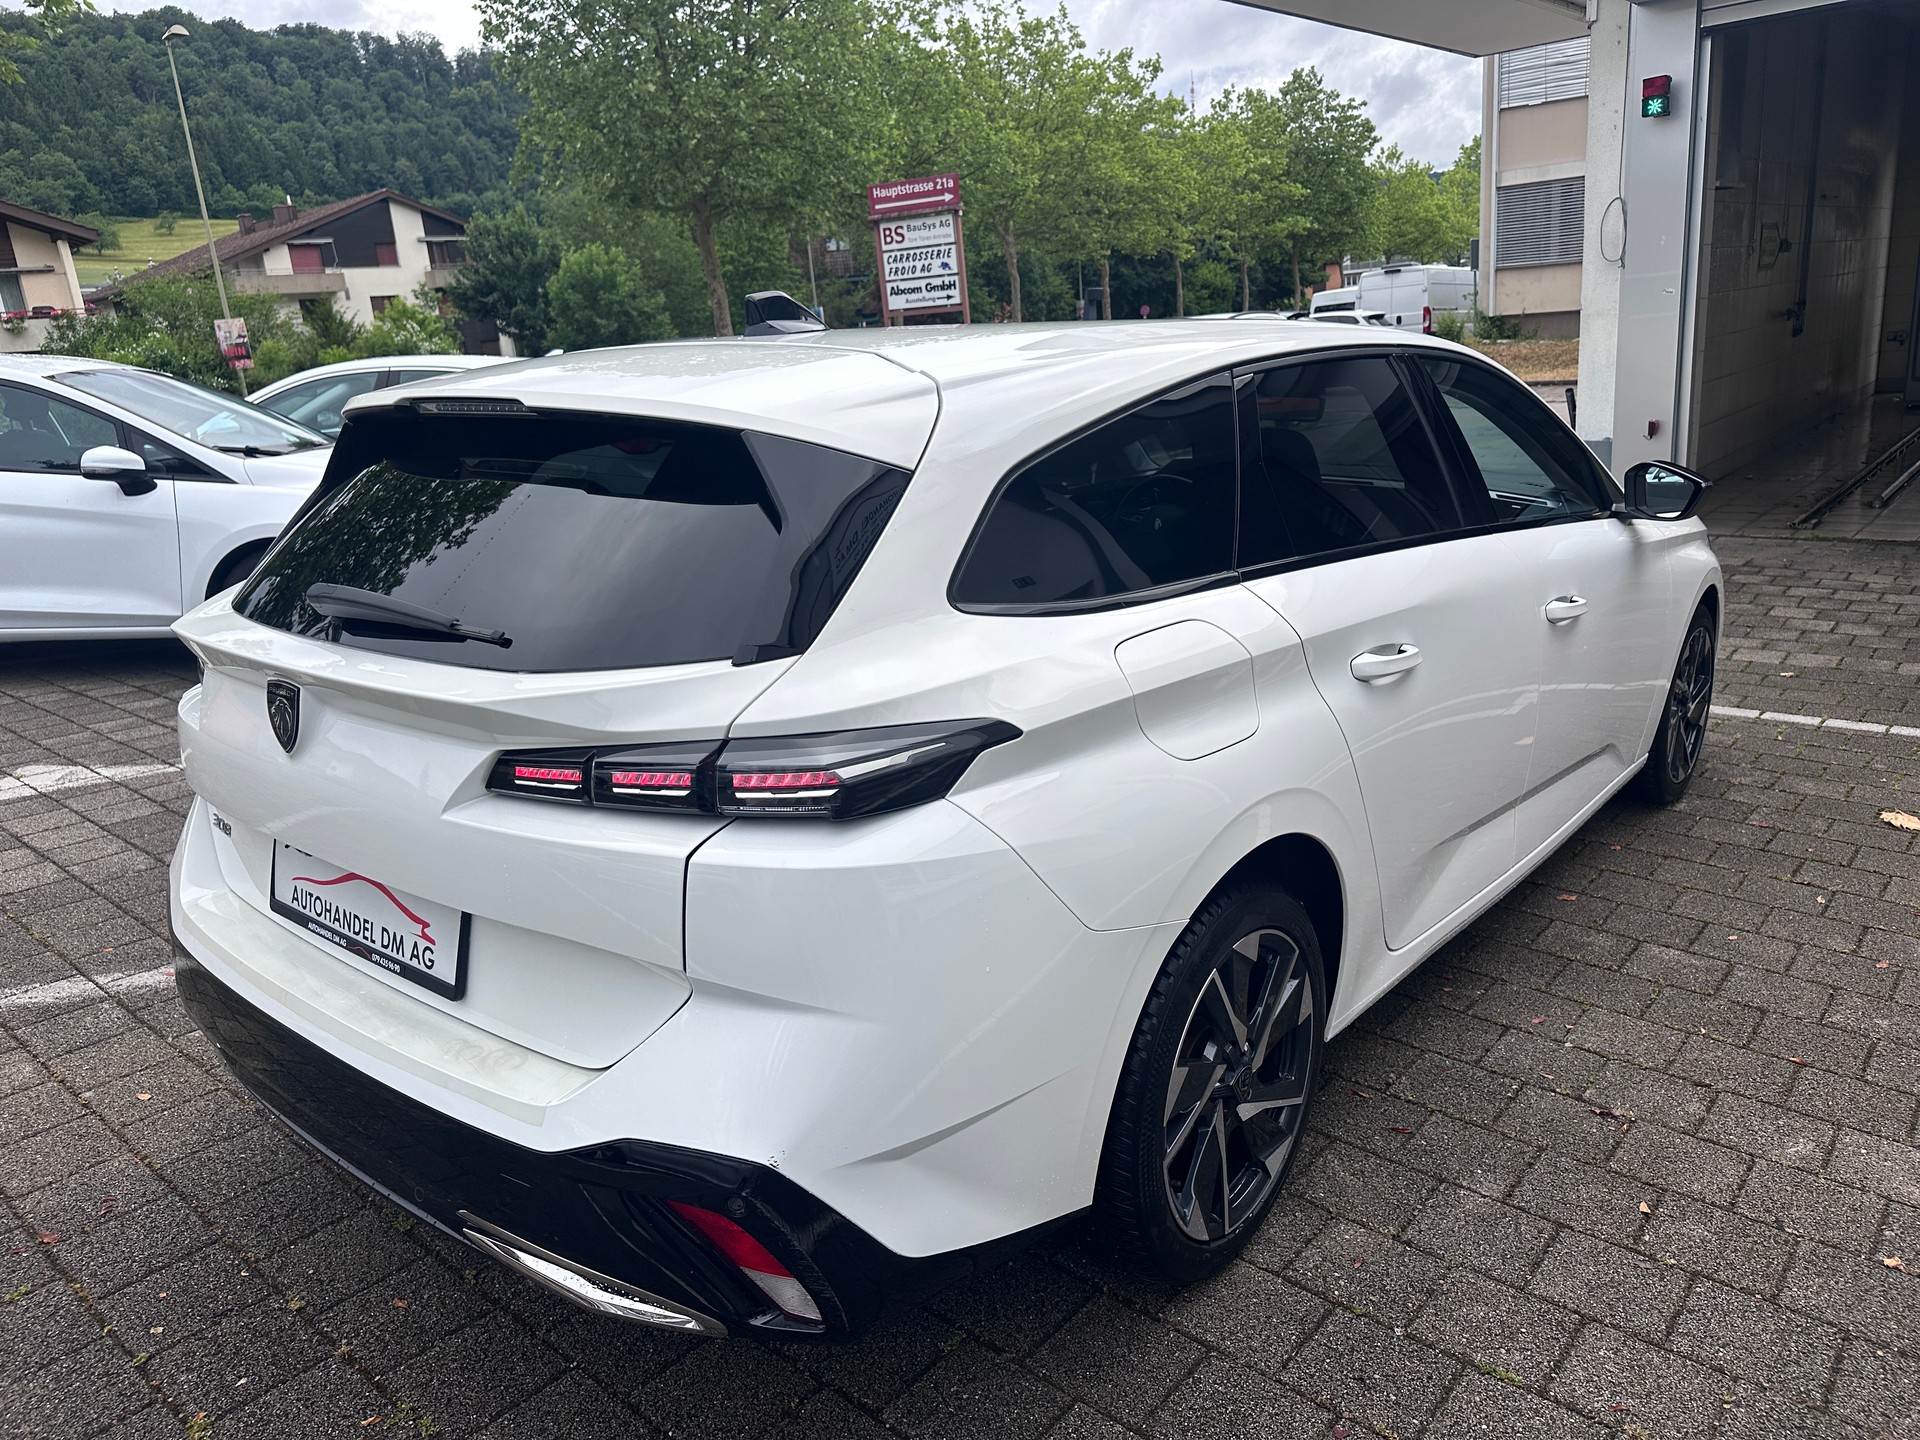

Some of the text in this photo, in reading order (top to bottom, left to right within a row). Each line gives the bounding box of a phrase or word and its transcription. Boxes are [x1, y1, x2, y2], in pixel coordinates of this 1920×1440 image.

[872, 178, 954, 199] Hauptstrasse 21a
[906, 218, 951, 232] BauSys AG
[883, 225, 905, 245] BS
[886, 247, 952, 265] CARROSSERIE
[920, 262, 932, 274] AG
[889, 279, 957, 297] Abcom GmbH
[905, 296, 936, 304] Ausstellung
[269, 687, 294, 698] PEUGEOT
[213, 813, 232, 838] 308
[291, 885, 435, 970] AUTOHANDEL DM AG
[307, 922, 347, 947] AUTOHANDEL DM AG
